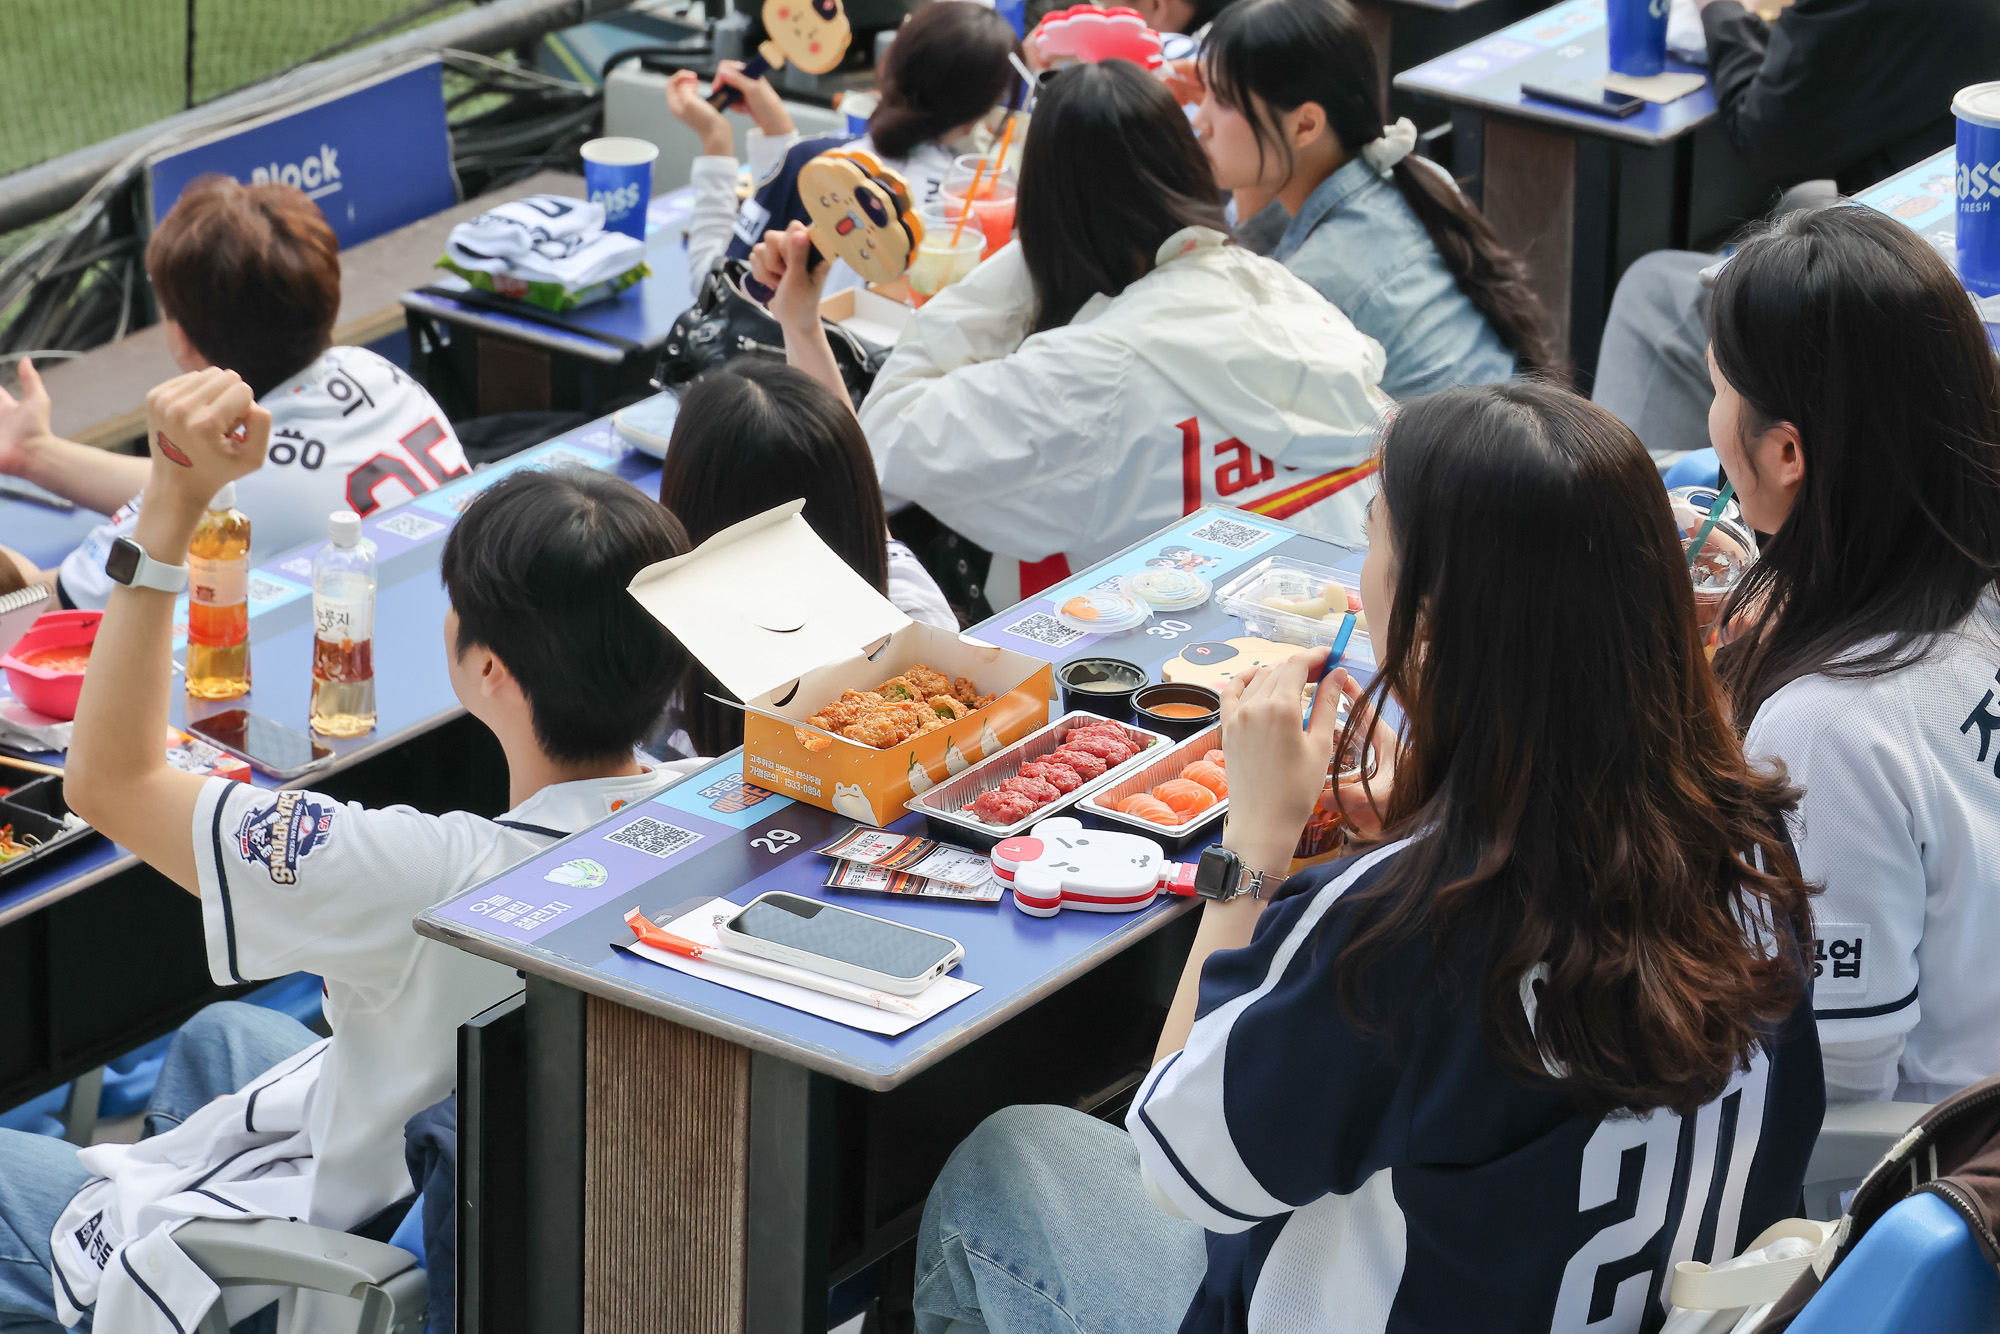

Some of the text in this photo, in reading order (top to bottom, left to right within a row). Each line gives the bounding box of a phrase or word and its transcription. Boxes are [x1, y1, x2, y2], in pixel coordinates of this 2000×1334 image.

[1960, 202, 1990, 213] FRESH
[1146, 621, 1192, 640] 30
[749, 765, 779, 784] 가맹문의
[750, 754, 821, 786] 고추튀김 맛있는 한식주점
[270, 791, 304, 884] CHAMPIONS
[750, 829, 802, 854] 29
[288, 840, 296, 863] SERIES
[512, 900, 573, 931] 챌린지
